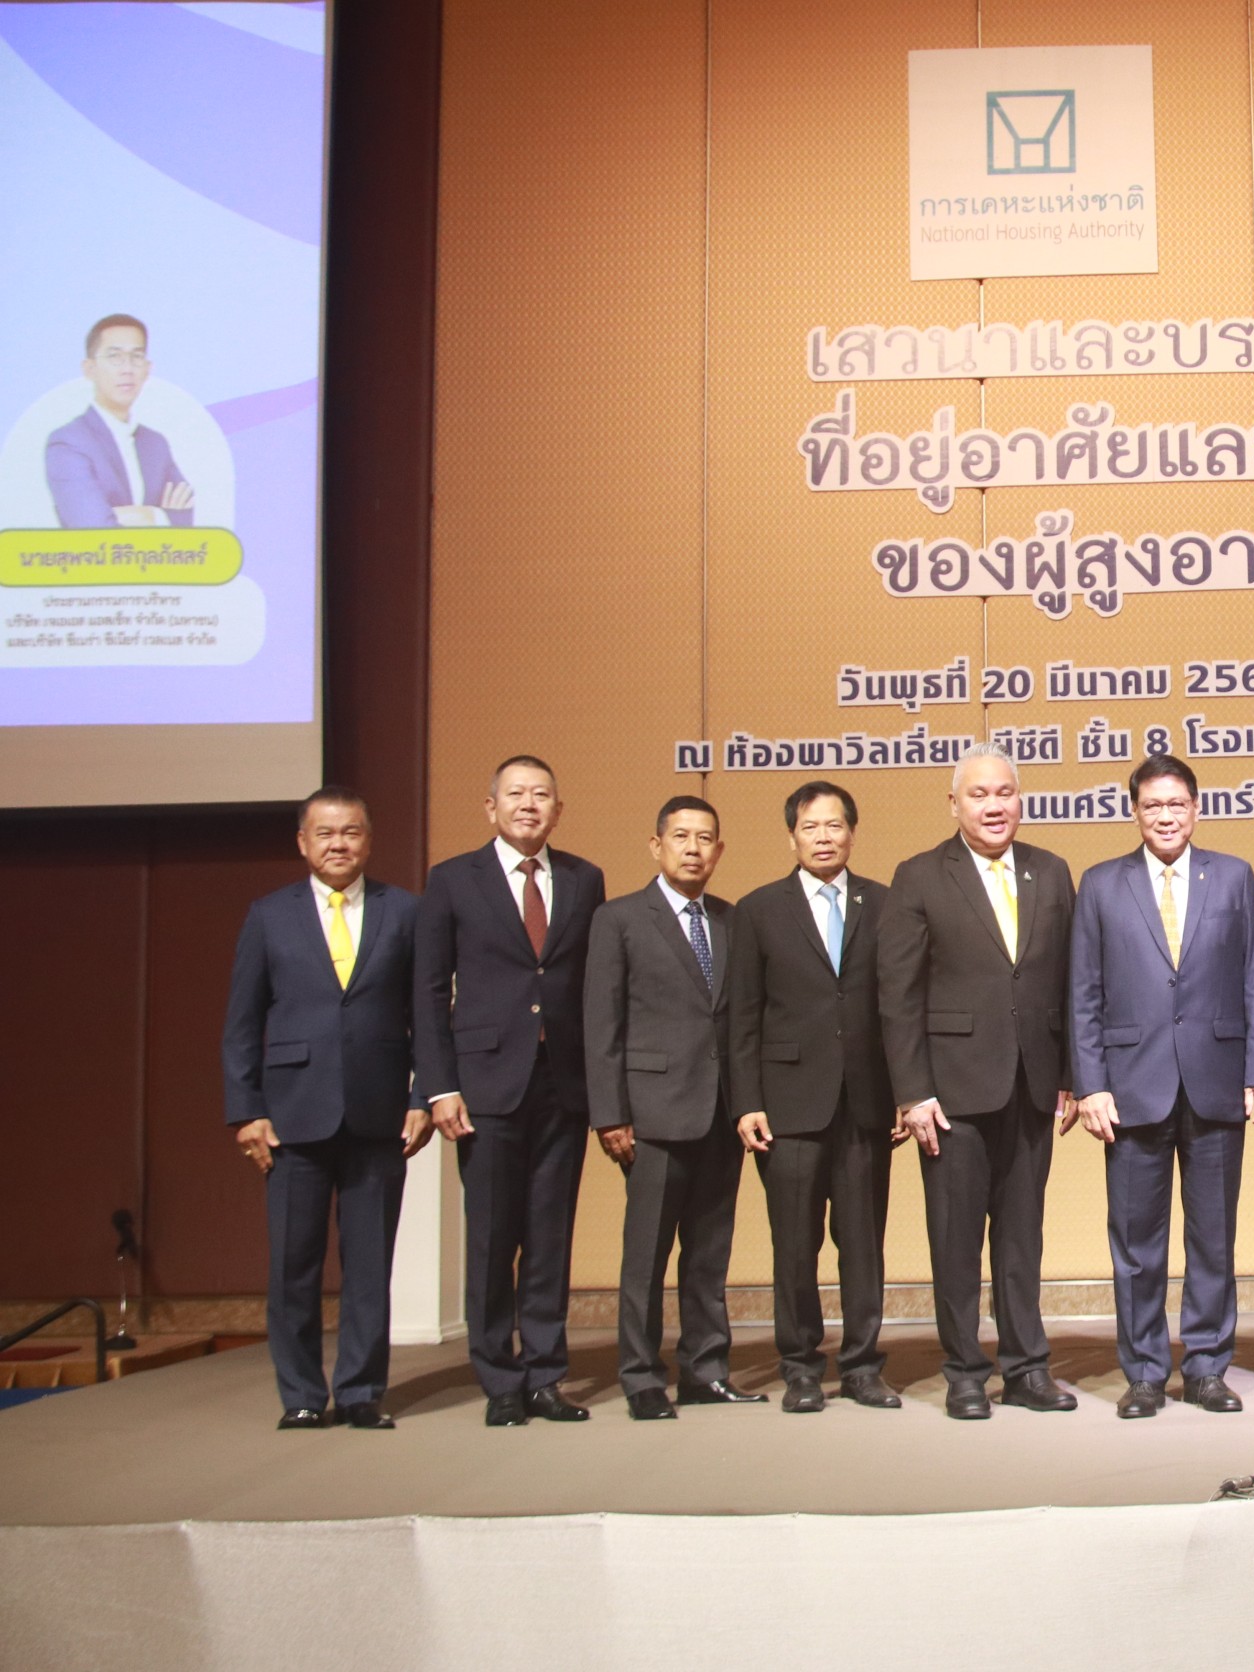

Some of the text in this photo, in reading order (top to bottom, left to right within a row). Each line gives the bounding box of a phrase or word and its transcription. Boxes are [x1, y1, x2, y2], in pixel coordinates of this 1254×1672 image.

[919, 184, 1145, 217] การเคหะแห่งชาติ
[920, 219, 1145, 245] National Housing Authority
[840, 658, 968, 710] วันพุธที่
[984, 669, 1031, 699] 20
[1050, 665, 1168, 698] มีนาคม
[677, 744, 711, 769] ณ
[1081, 721, 1129, 759] ชั้น
[1146, 728, 1170, 757] 8
